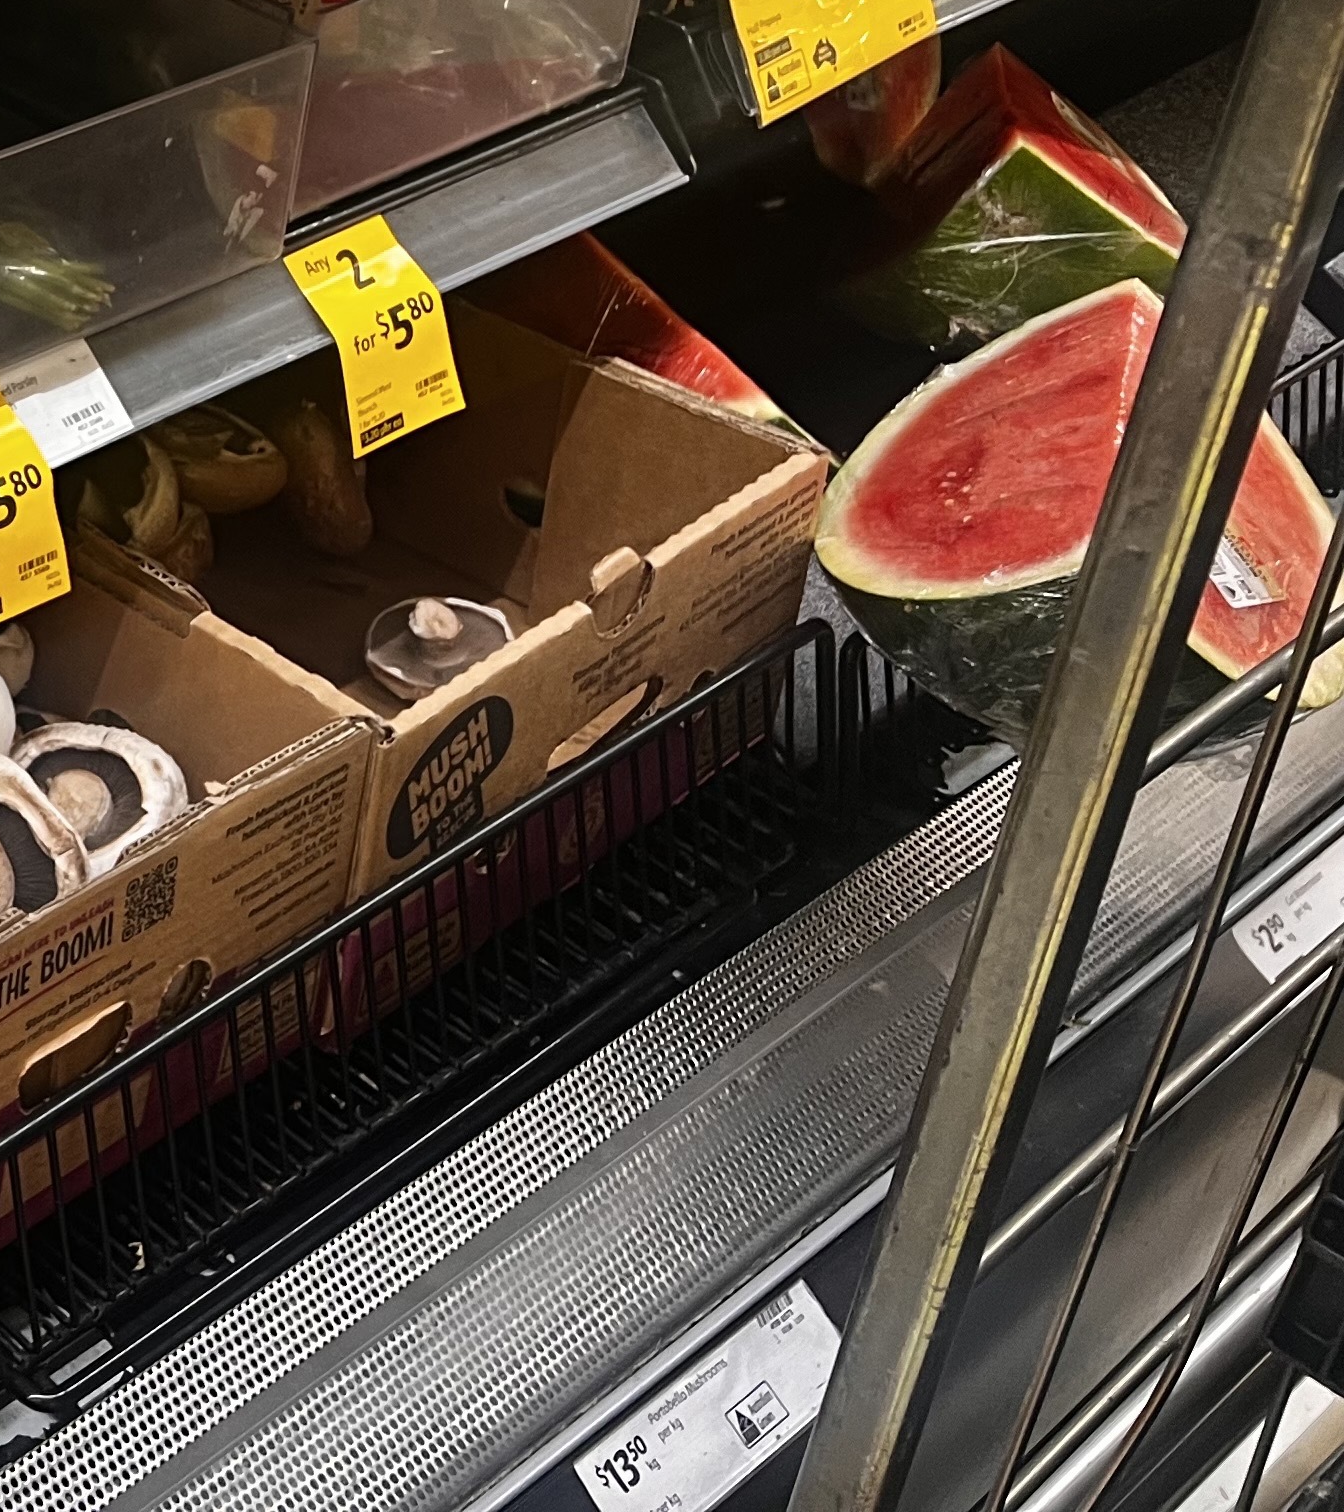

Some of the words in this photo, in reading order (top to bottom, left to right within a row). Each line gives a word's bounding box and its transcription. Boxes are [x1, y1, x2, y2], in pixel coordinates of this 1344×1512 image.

[304, 256, 330, 276] Any
[336, 249, 375, 289] 2
[354, 332, 375, 355] for
[408, 705, 489, 810] MUSH
[412, 734, 493, 839] BOOM!
[38, 912, 114, 986] BOOM!
